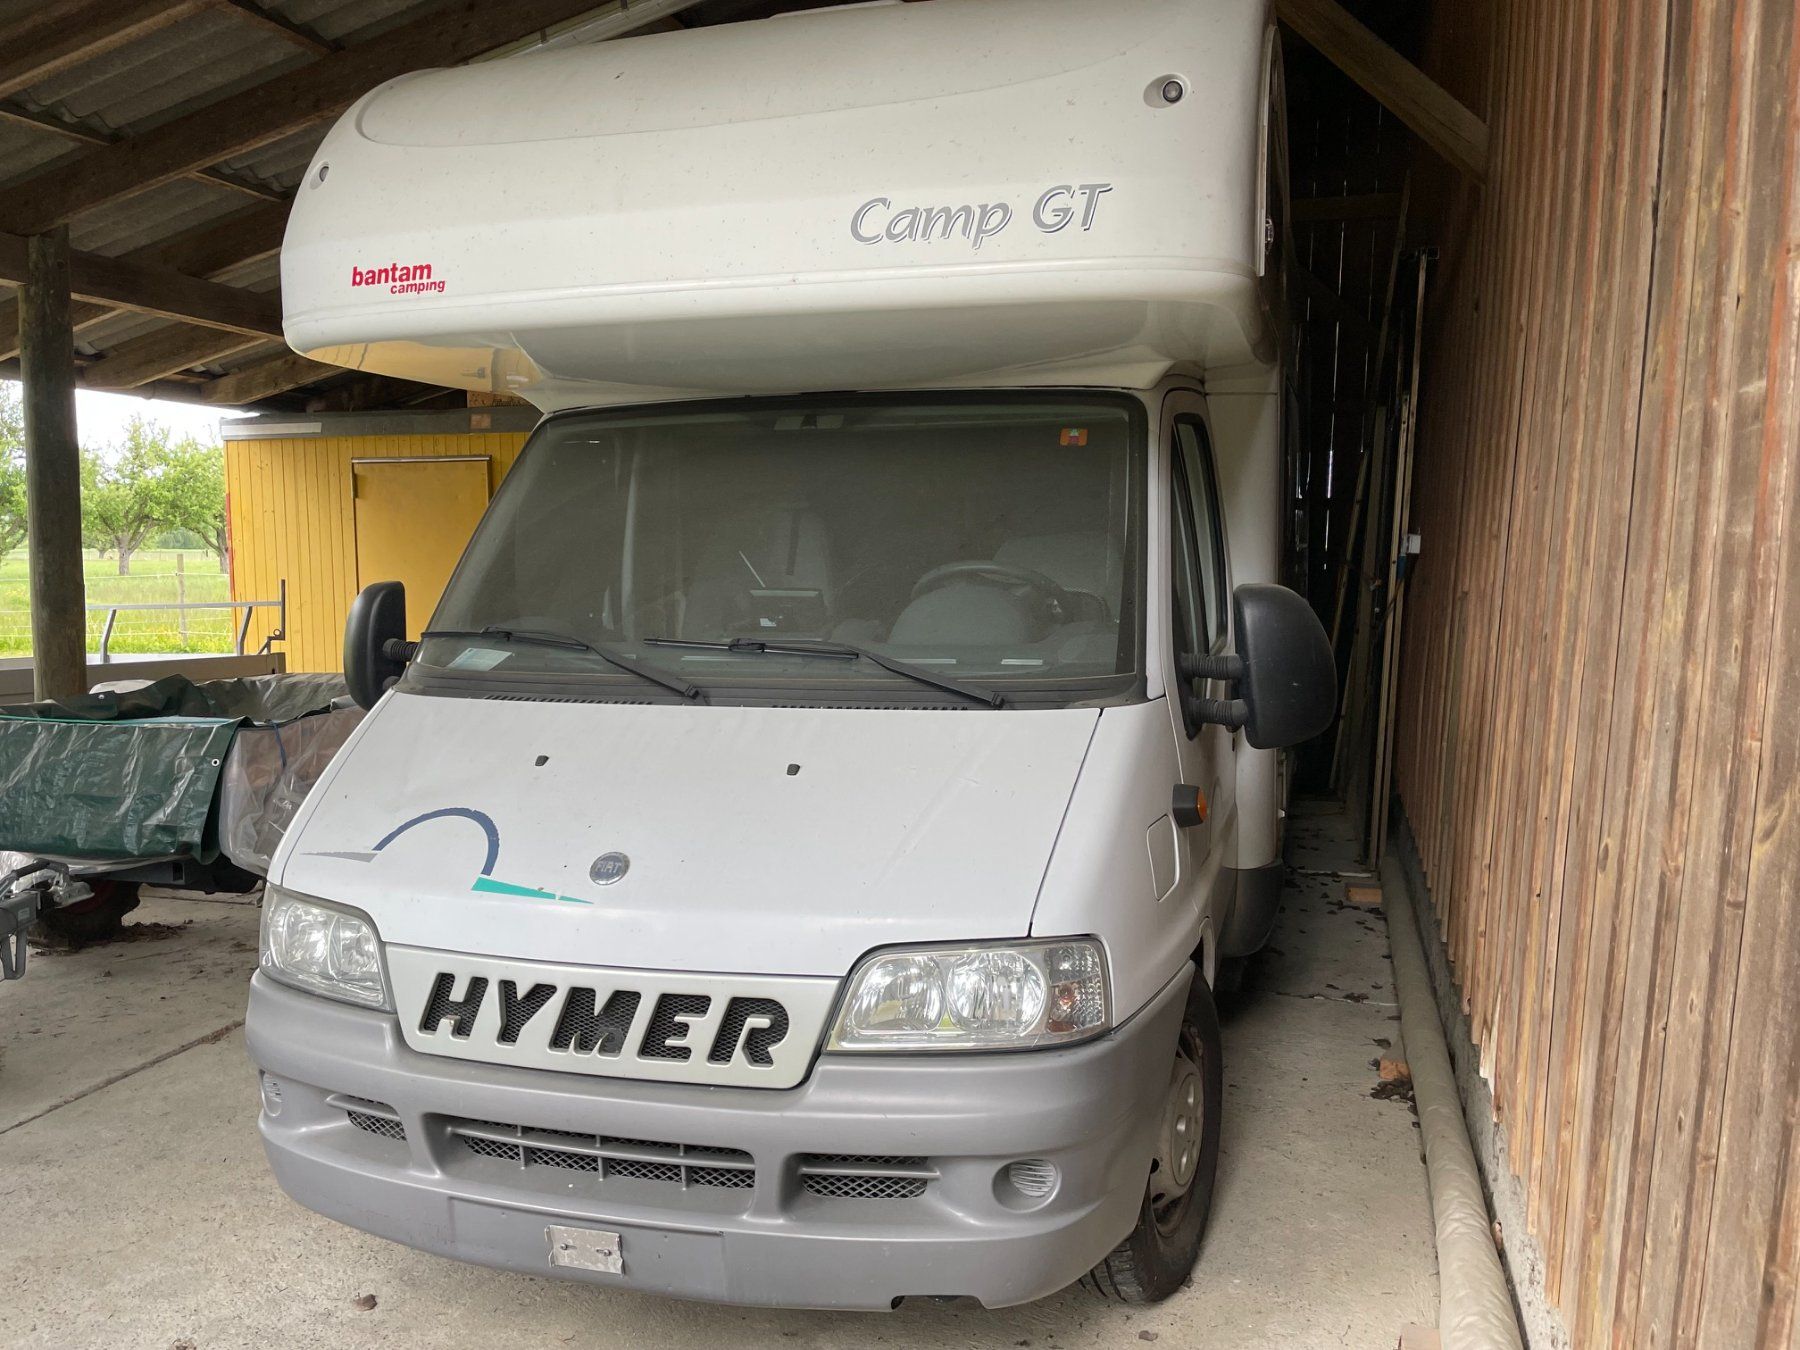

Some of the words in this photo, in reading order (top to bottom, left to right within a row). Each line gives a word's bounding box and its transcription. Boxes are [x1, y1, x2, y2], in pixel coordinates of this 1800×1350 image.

[850, 197, 1012, 250] Camp
[1032, 183, 1113, 233] GT
[352, 262, 432, 286] bantam
[390, 280, 446, 294] camping
[417, 972, 789, 1069] HYMER
